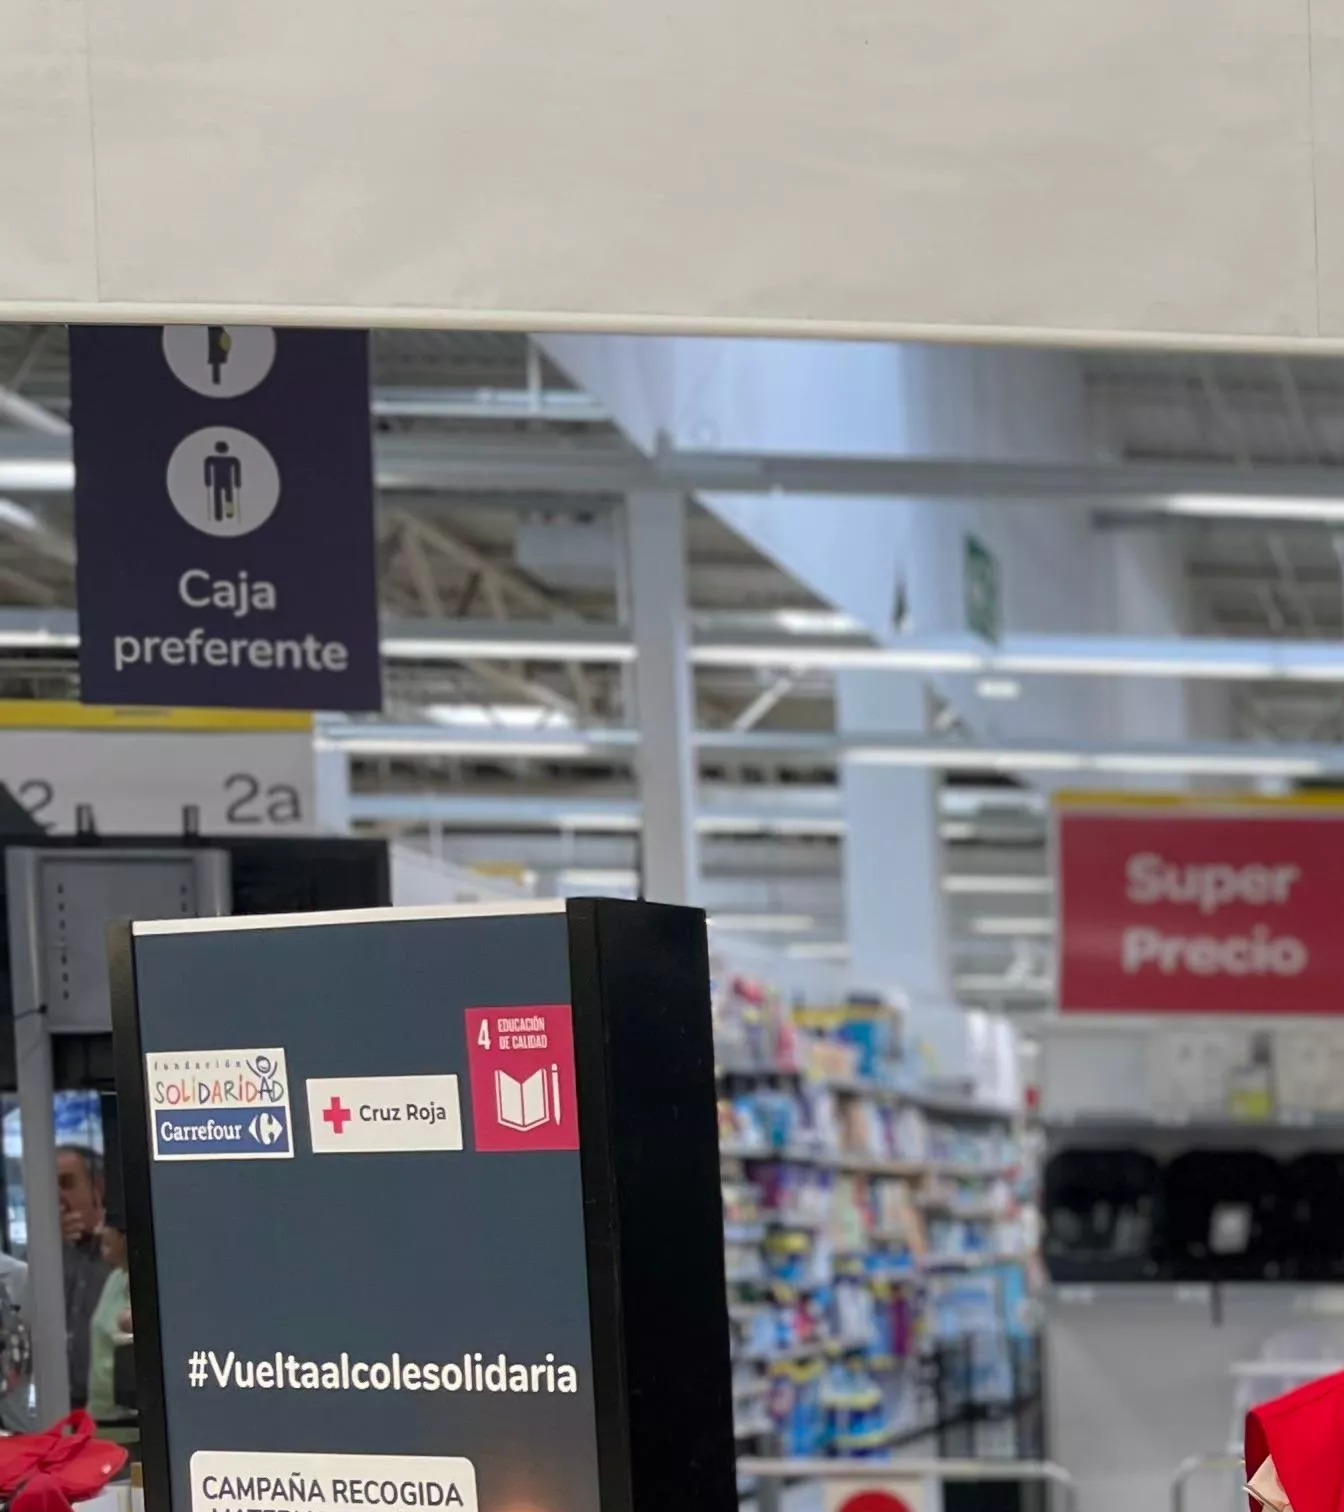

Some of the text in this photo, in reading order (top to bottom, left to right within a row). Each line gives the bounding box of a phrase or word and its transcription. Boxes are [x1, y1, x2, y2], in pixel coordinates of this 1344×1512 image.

[178, 569, 276, 617] Caja
[113, 628, 349, 671] preferente
[223, 774, 302, 824] 2a
[1124, 852, 1301, 915] Super
[1121, 923, 1308, 976] Precio
[478, 1016, 546, 1051] 4 EDUCACIÓN
[499, 1034, 548, 1050] DE CALIDAD
[160, 1119, 242, 1142] Carrefour
[359, 1103, 447, 1125] Cruz Roja
[188, 1350, 578, 1393] #Vueltaalcolesolidaria
[202, 1472, 464, 1507] CAMPAÑA RECOGIDA
